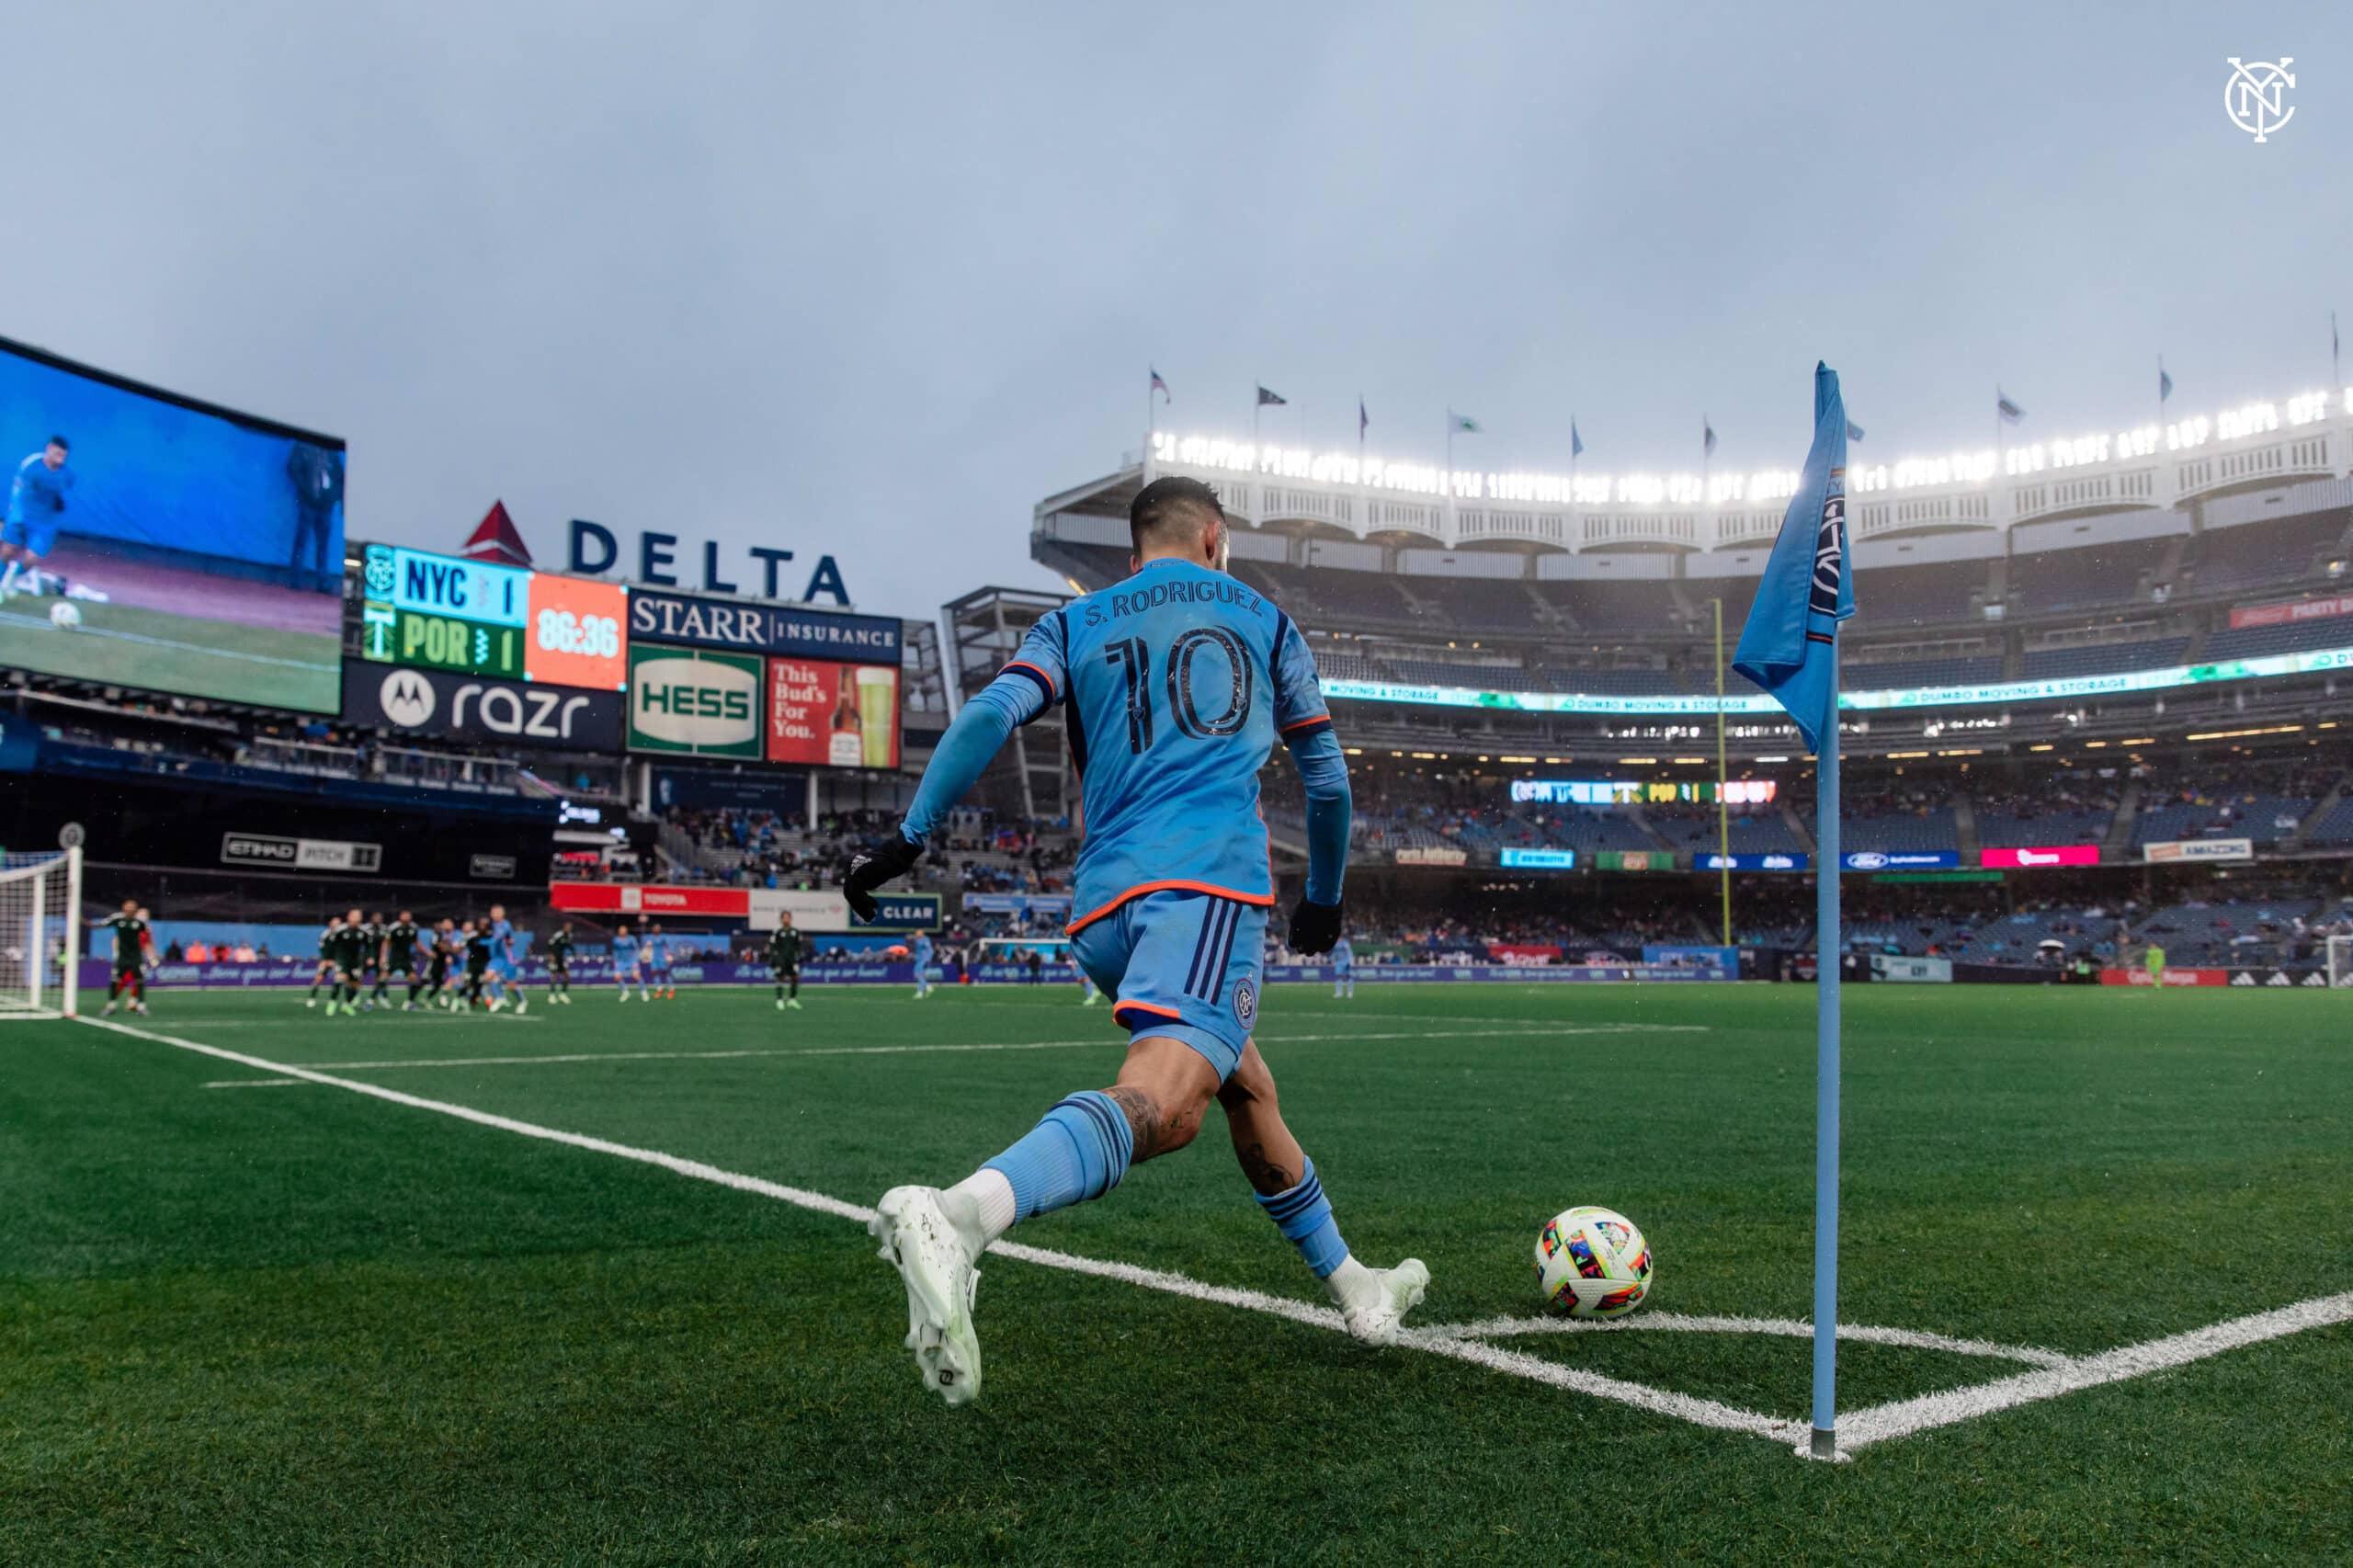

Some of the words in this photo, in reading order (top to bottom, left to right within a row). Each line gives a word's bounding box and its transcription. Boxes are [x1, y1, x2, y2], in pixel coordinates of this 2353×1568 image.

[569, 518, 850, 606] DELTA
[405, 558, 466, 607] NYC
[1112, 580, 1262, 619] RODRIGUEZ
[404, 613, 468, 666] POR
[632, 597, 767, 645] STARR
[778, 621, 895, 648] INSURANCE
[774, 663, 818, 684] This
[1105, 625, 1254, 756] 10
[1979, 686, 2039, 699] MOVING
[2061, 677, 2127, 692] STORAGE
[452, 684, 590, 738] razr
[642, 682, 749, 721] HESS
[775, 701, 808, 720] For
[1392, 688, 1438, 699] STORAGE
[883, 906, 933, 920] CLEAR
